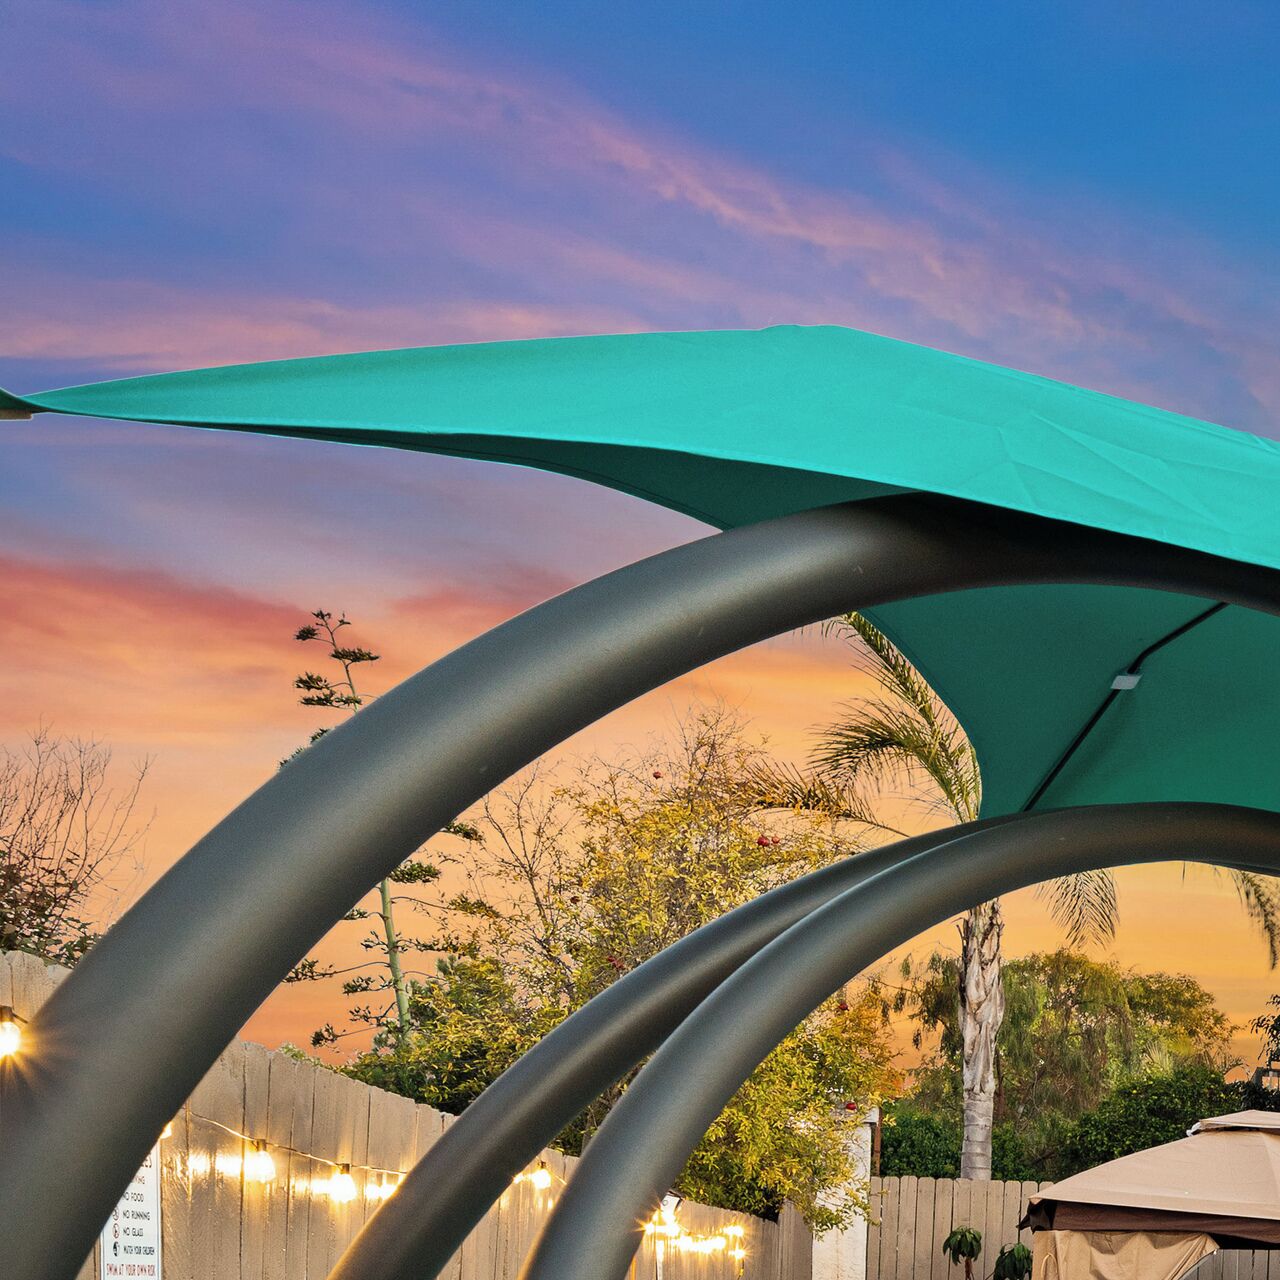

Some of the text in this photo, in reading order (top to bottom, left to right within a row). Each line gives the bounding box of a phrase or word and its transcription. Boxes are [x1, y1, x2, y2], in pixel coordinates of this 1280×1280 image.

[131, 1192, 144, 1202] FOOD
[123, 1210, 151, 1221] NO RUNNING
[123, 1227, 130, 1236] NO
